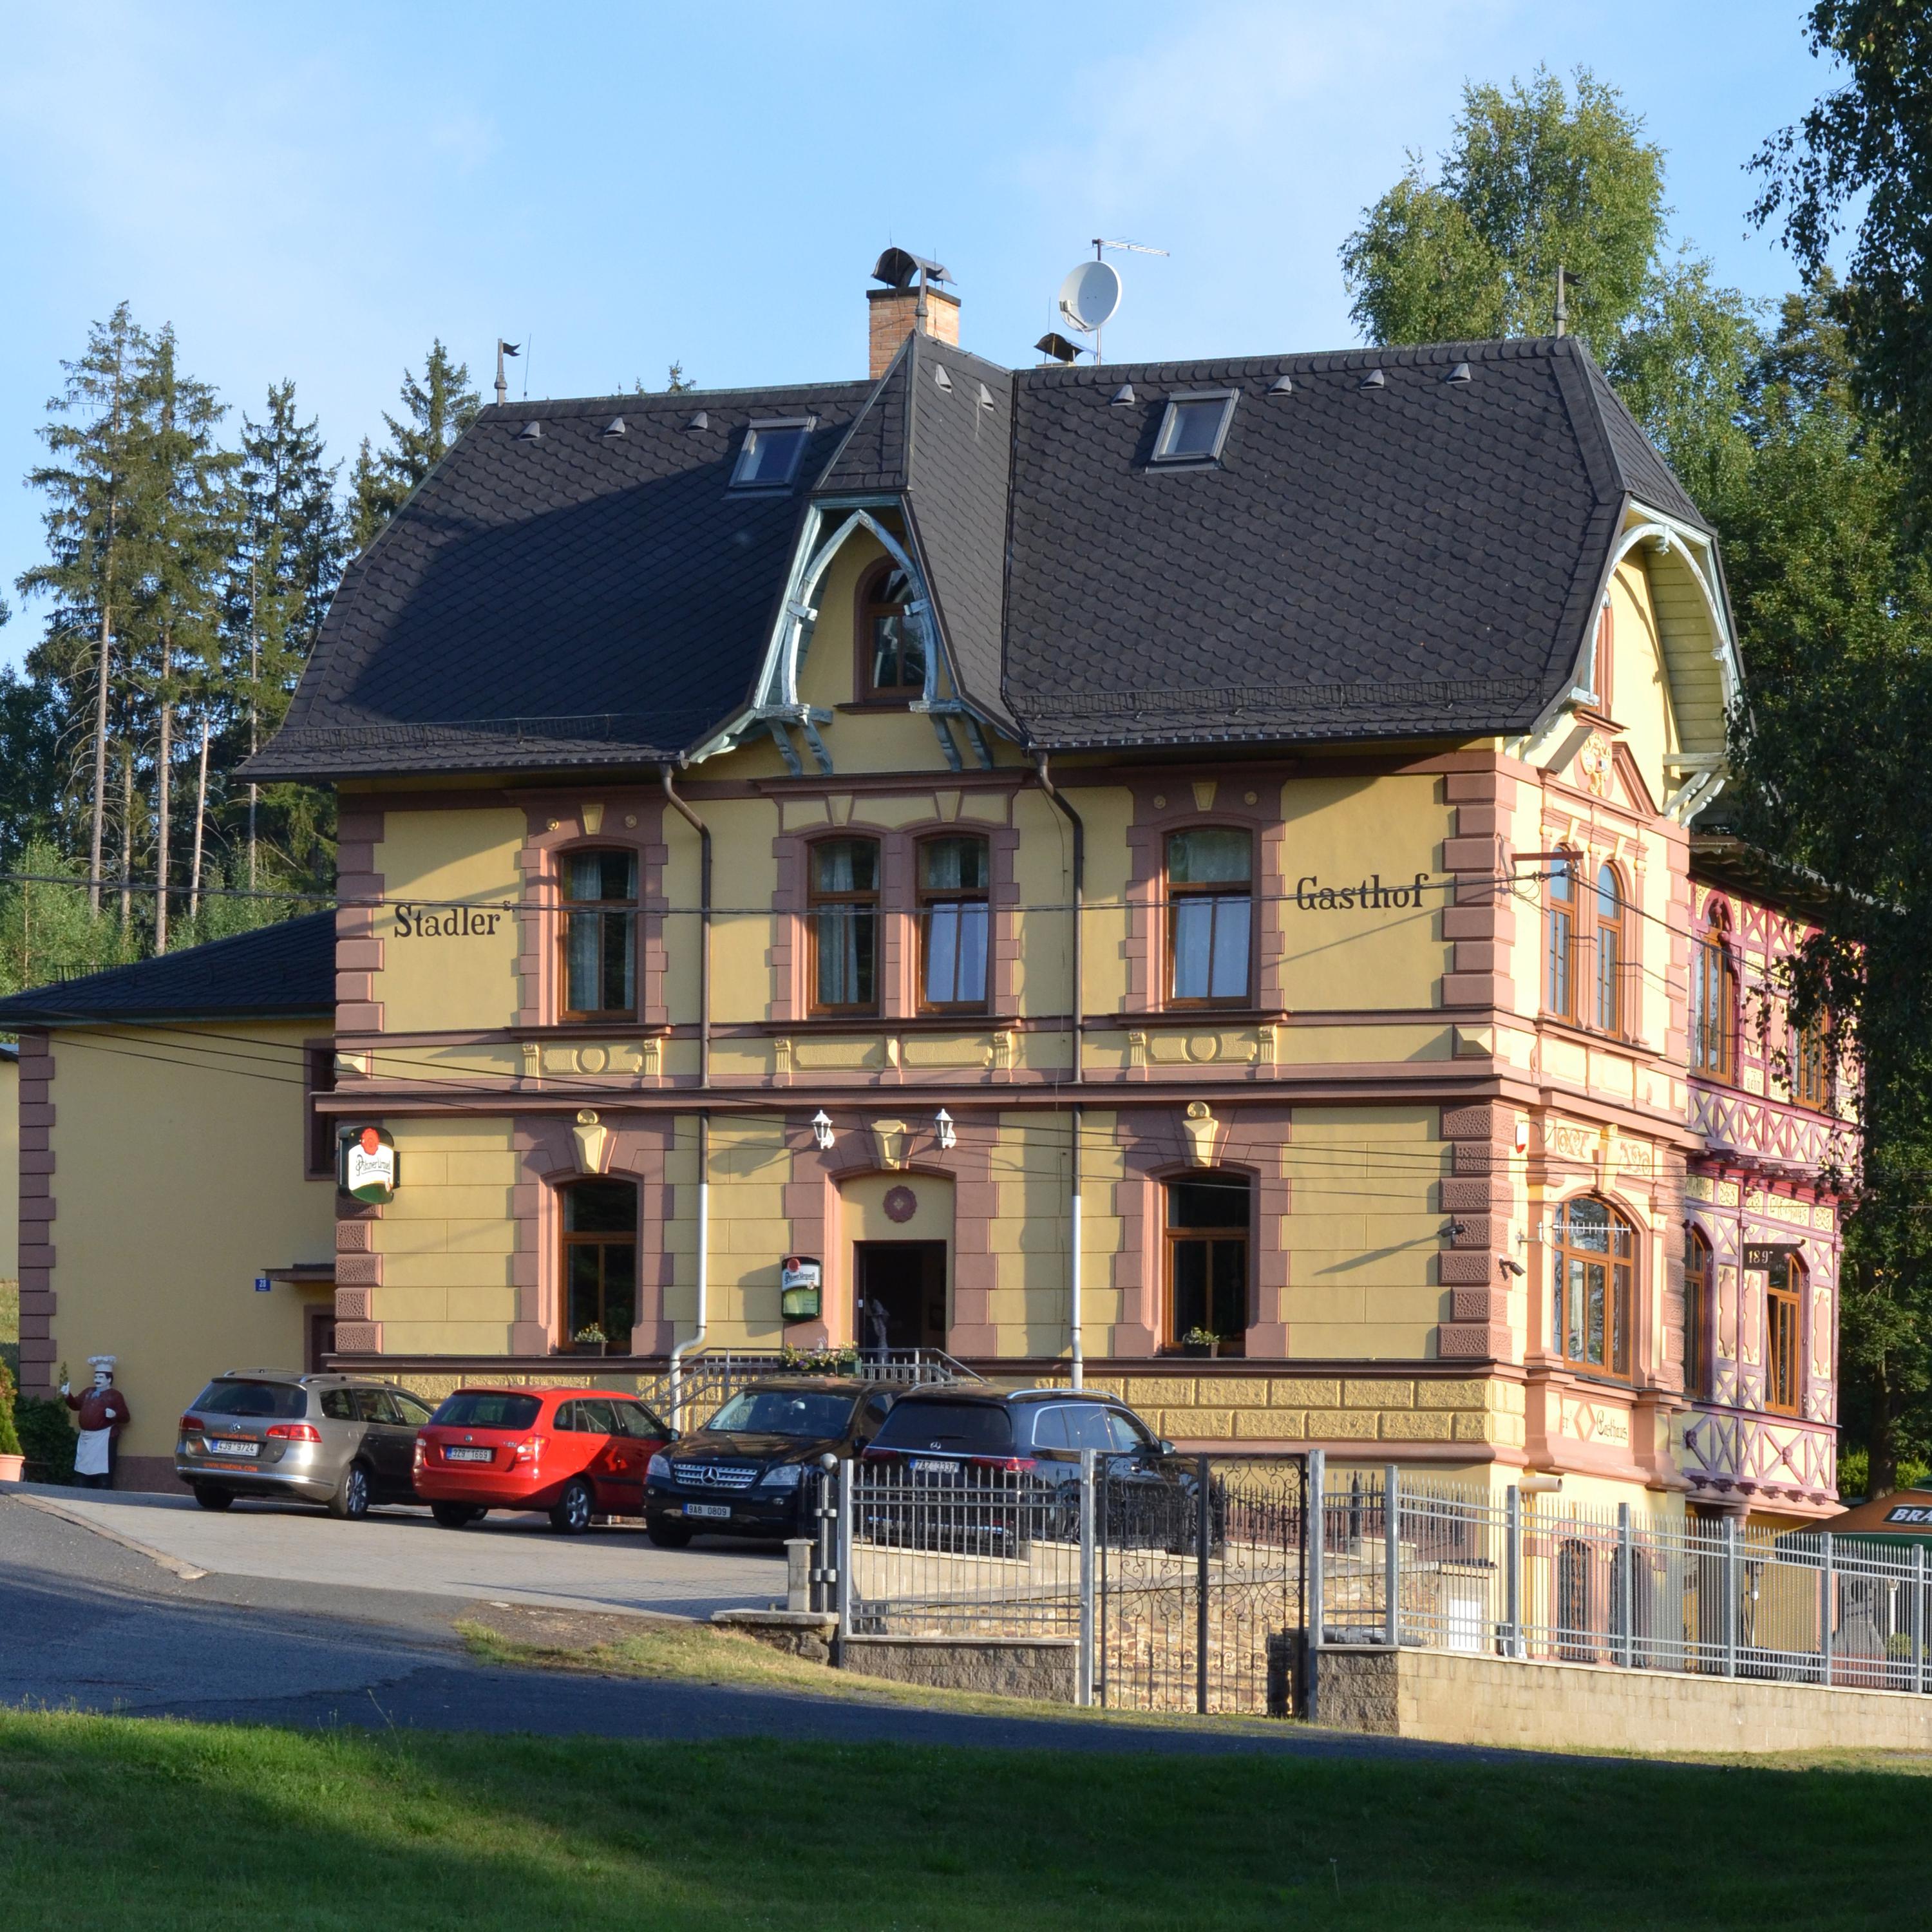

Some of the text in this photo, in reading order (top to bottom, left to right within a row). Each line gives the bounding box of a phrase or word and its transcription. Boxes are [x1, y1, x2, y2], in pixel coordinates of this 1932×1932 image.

[1296, 873, 1430, 911] Gasthof
[1748, 1250, 1774, 1264] 189
[218, 1442, 254, 1452] 4J9 9724
[688, 1504, 727, 1516] 9A8 0809
